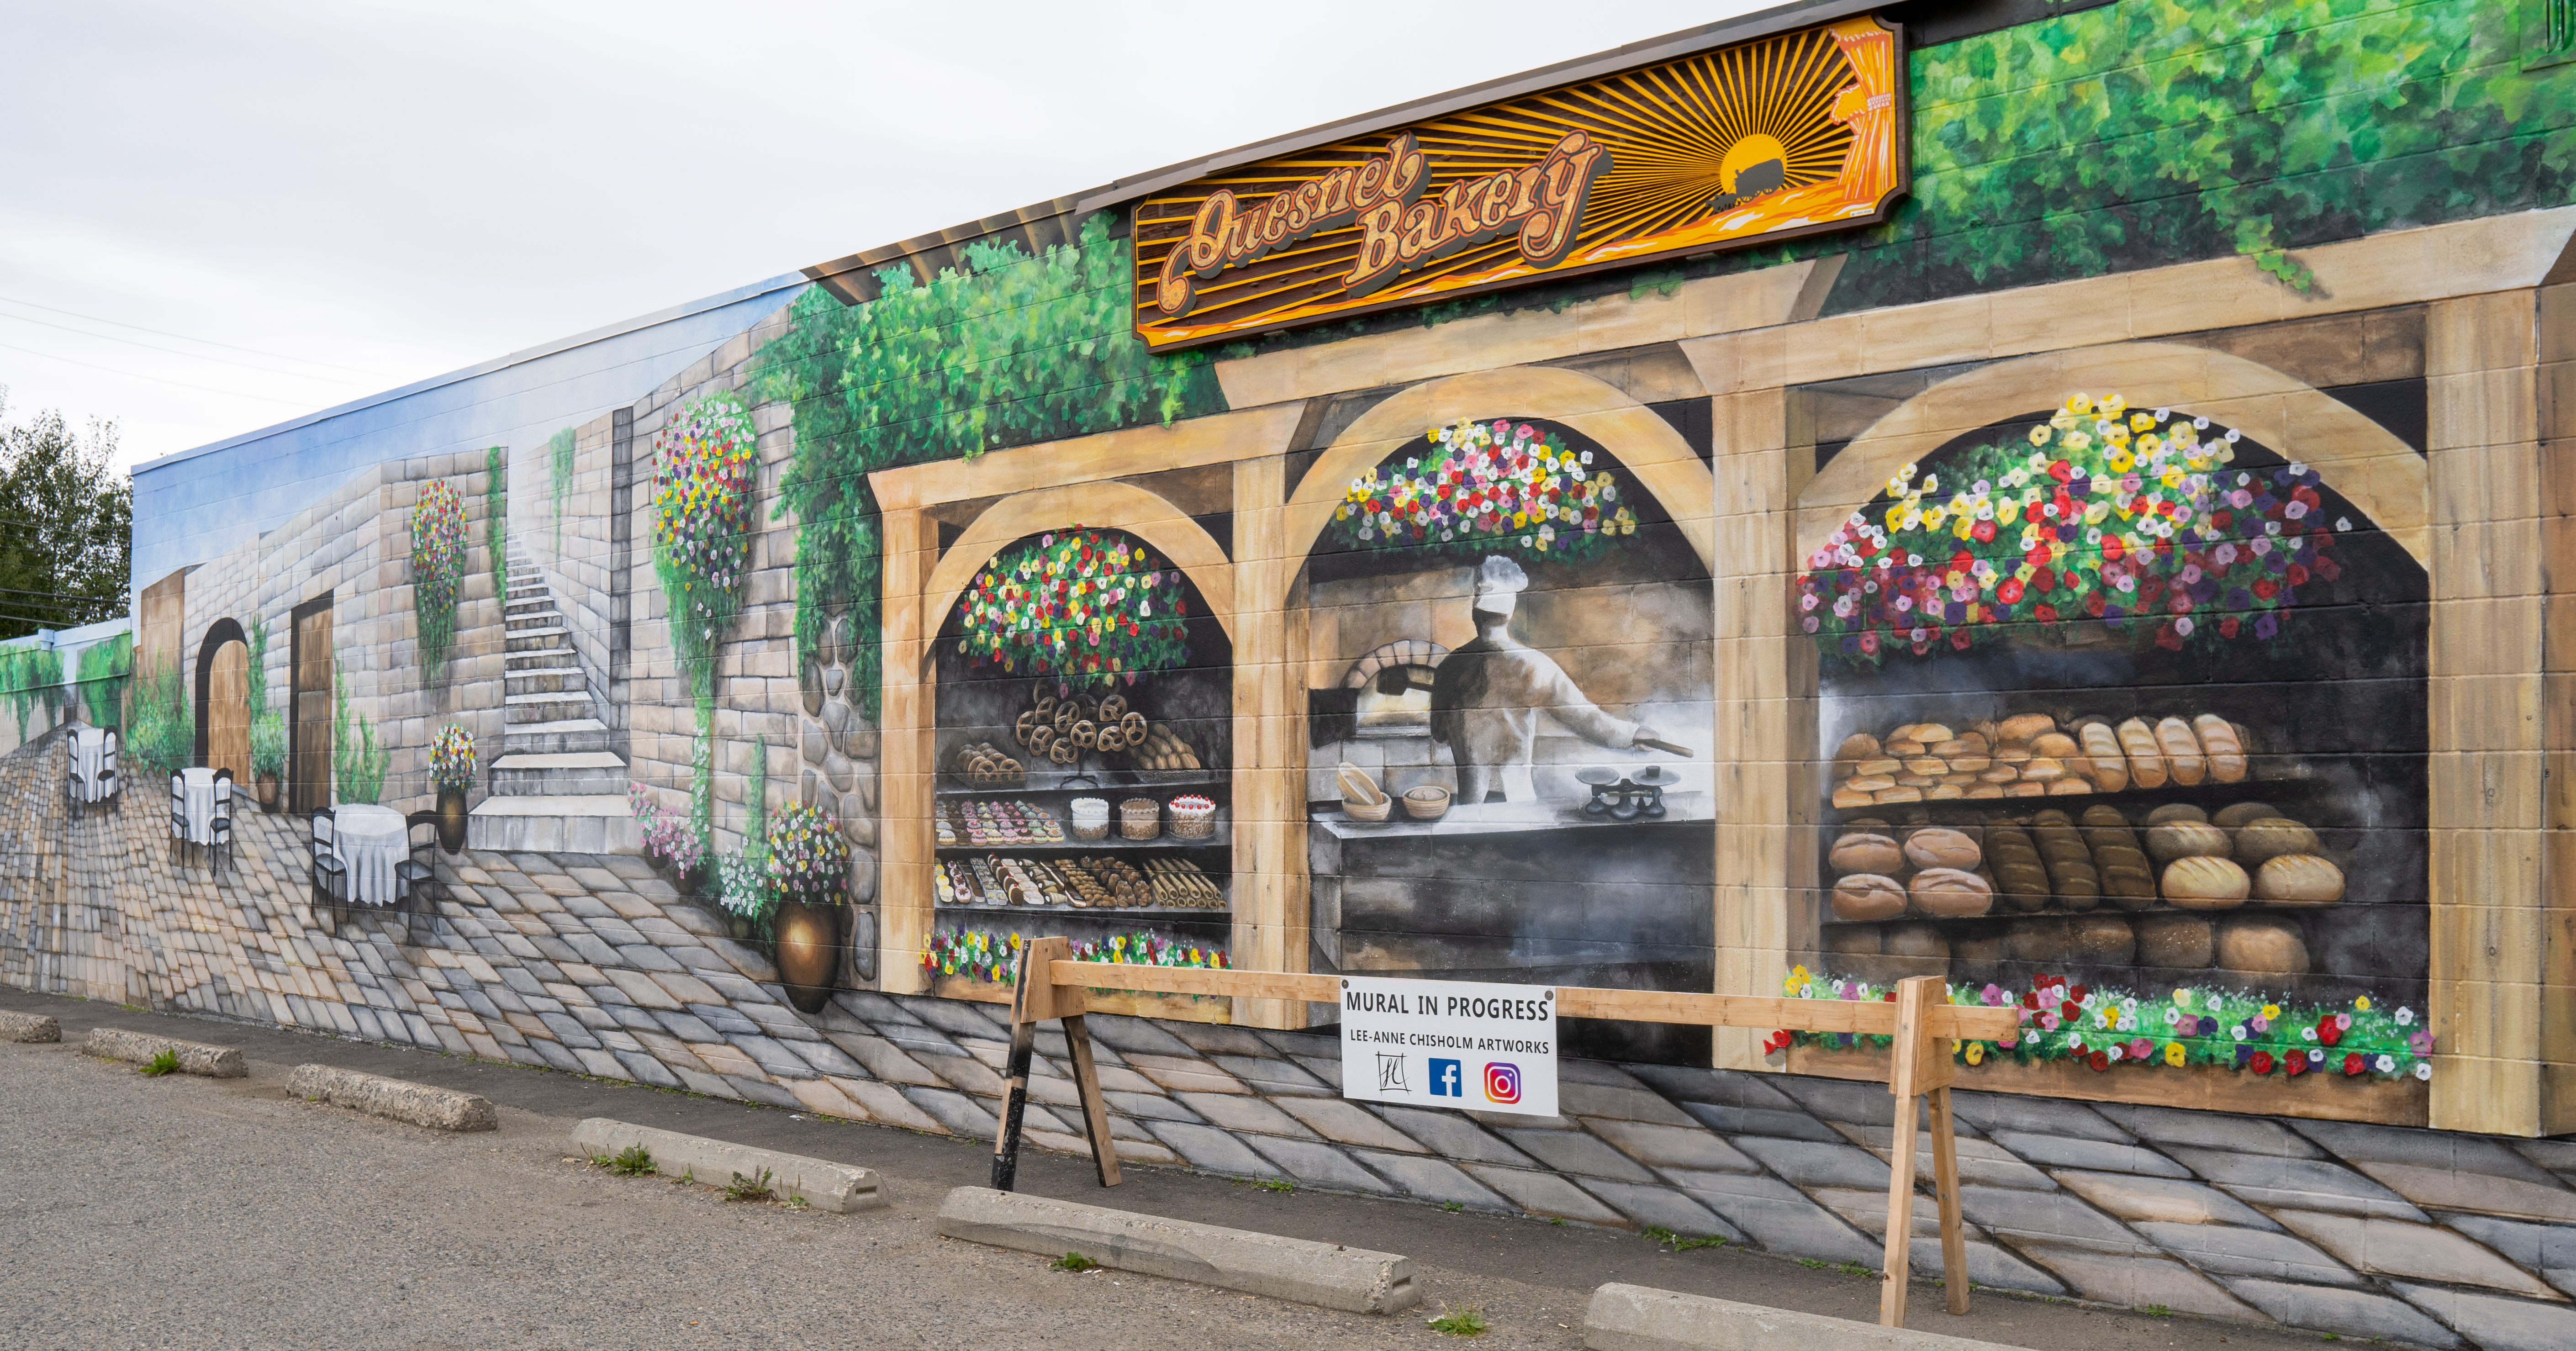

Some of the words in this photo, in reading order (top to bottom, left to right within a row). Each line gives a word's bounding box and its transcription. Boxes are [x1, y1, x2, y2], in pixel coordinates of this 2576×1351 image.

[1157, 130, 1425, 314] Quesnel
[1342, 129, 1604, 290] Bakery
[1346, 992, 1409, 1013] MURAL
[1418, 996, 1438, 1015] IN
[1448, 997, 1548, 1021] PROGRESS
[1351, 1029, 1405, 1045] LEE-ANNE
[1409, 1033, 1473, 1049] CHISHOLM
[1478, 1038, 1549, 1054] ARTWORKS
